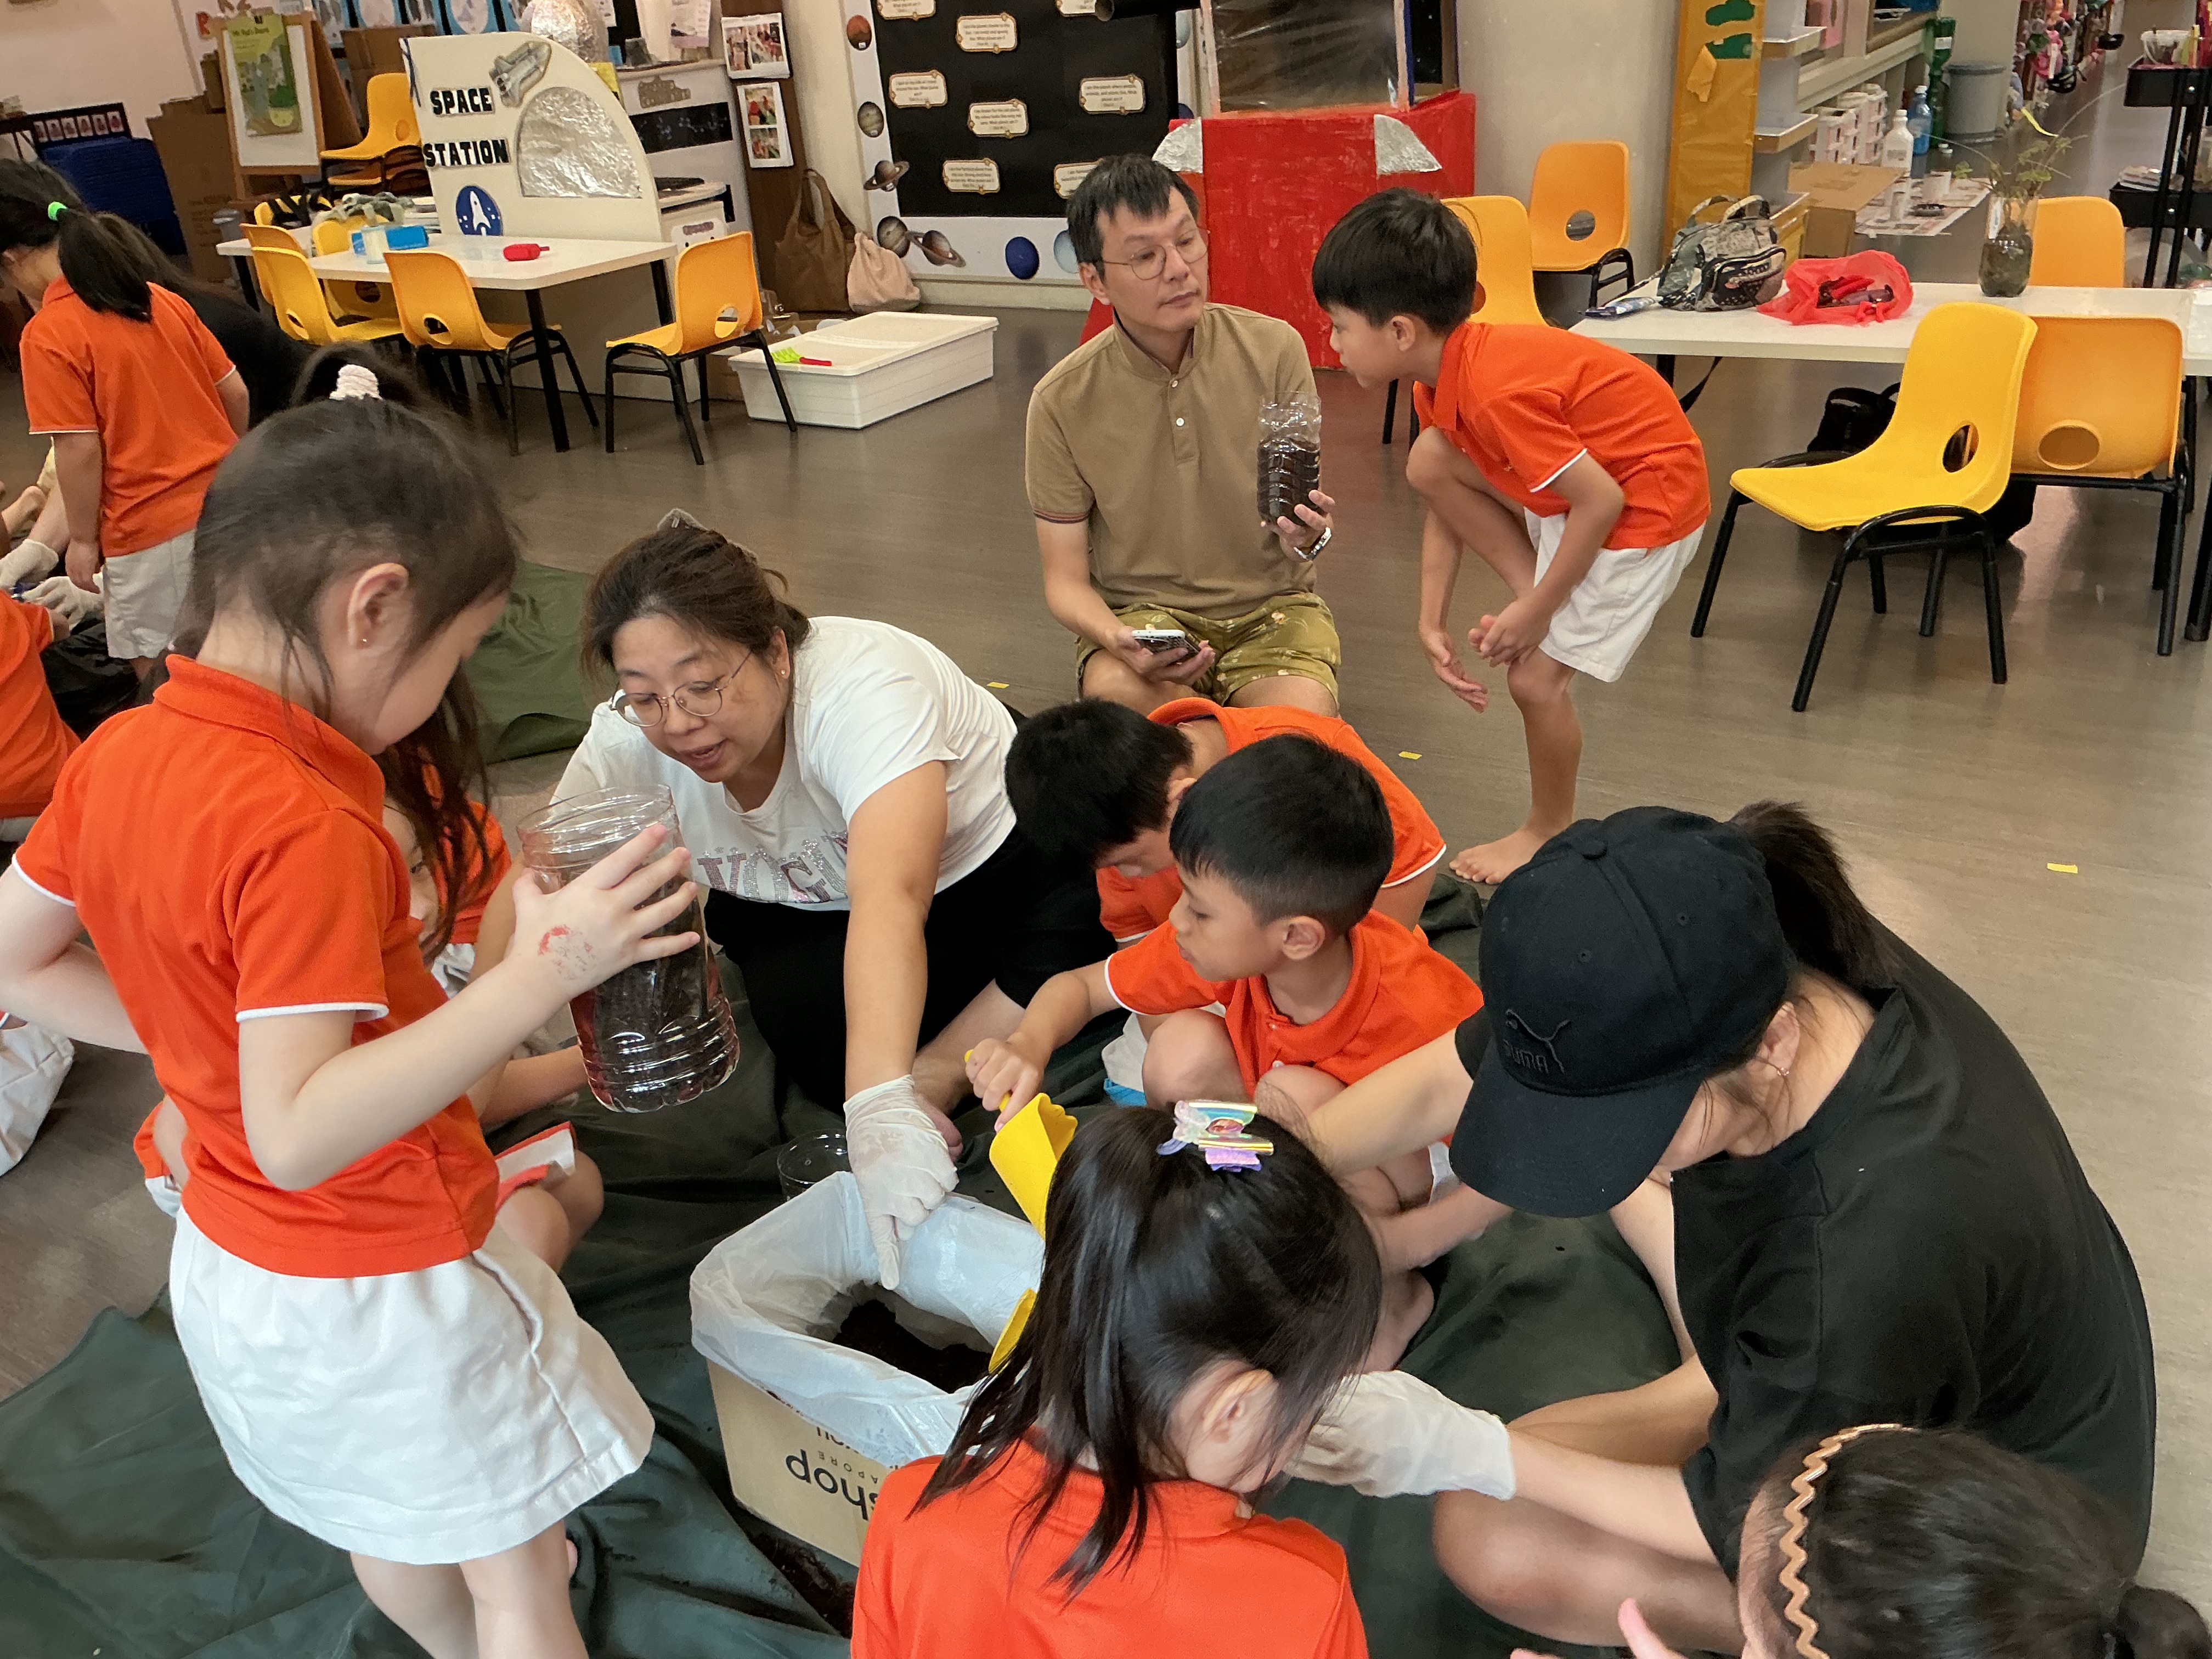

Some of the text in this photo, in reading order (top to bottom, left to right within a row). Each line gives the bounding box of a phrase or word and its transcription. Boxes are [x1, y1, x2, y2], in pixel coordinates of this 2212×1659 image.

[430, 87, 493, 115] SPACE
[422, 139, 510, 167] STATION
[697, 830, 848, 904] VOGU
